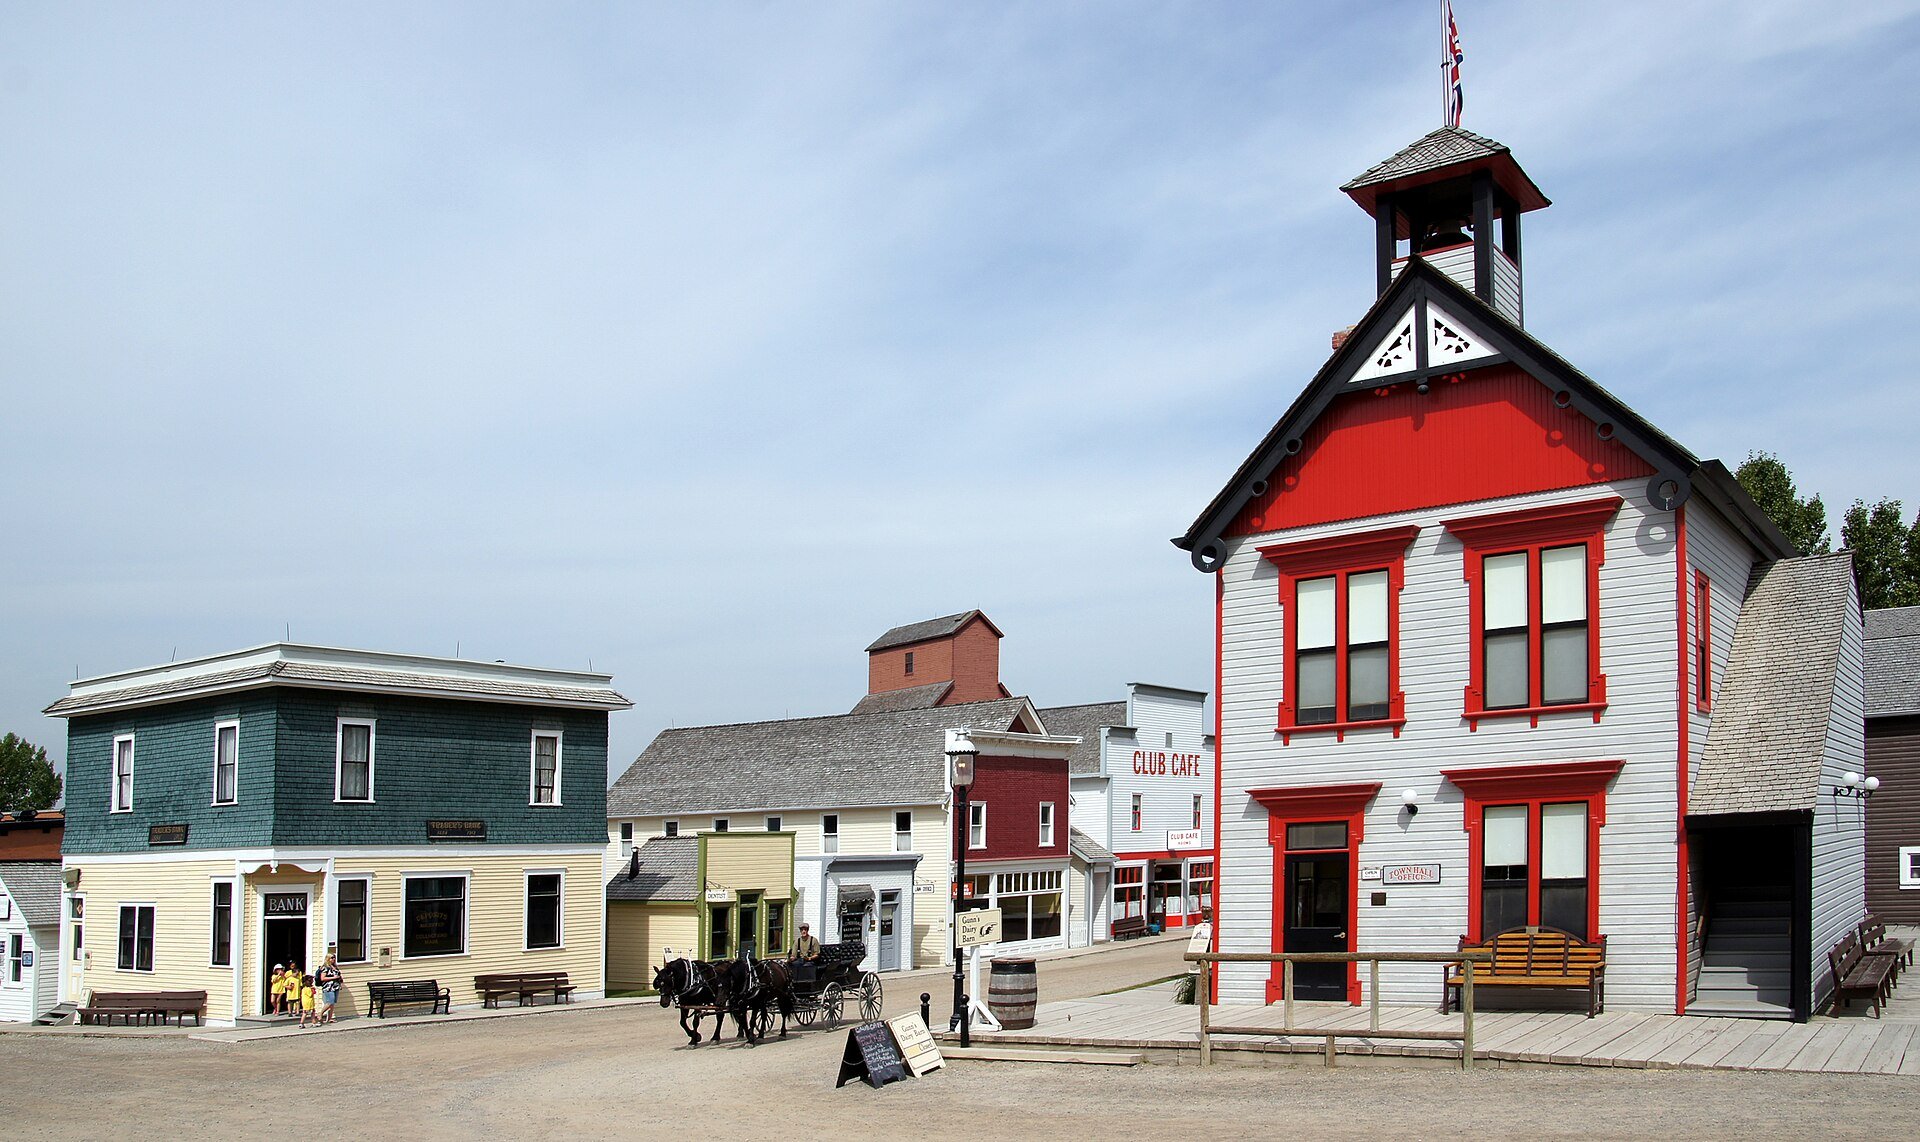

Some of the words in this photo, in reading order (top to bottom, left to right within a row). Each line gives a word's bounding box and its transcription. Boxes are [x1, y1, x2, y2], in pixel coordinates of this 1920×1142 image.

[1133, 750, 1166, 775] CLUB
[1171, 753, 1201, 776] CAFE
[1389, 867, 1411, 879] TOWN
[1413, 866, 1435, 879] HALL
[1397, 873, 1426, 881] OFFICE
[269, 897, 304, 911] BANK
[961, 915, 981, 925] Gunn's
[962, 925, 978, 934] Dairy
[962, 934, 976, 943] Barn
[901, 1021, 918, 1033] Gunn's
[900, 1033, 914, 1042] Dairy
[915, 1029, 926, 1037] Barn
